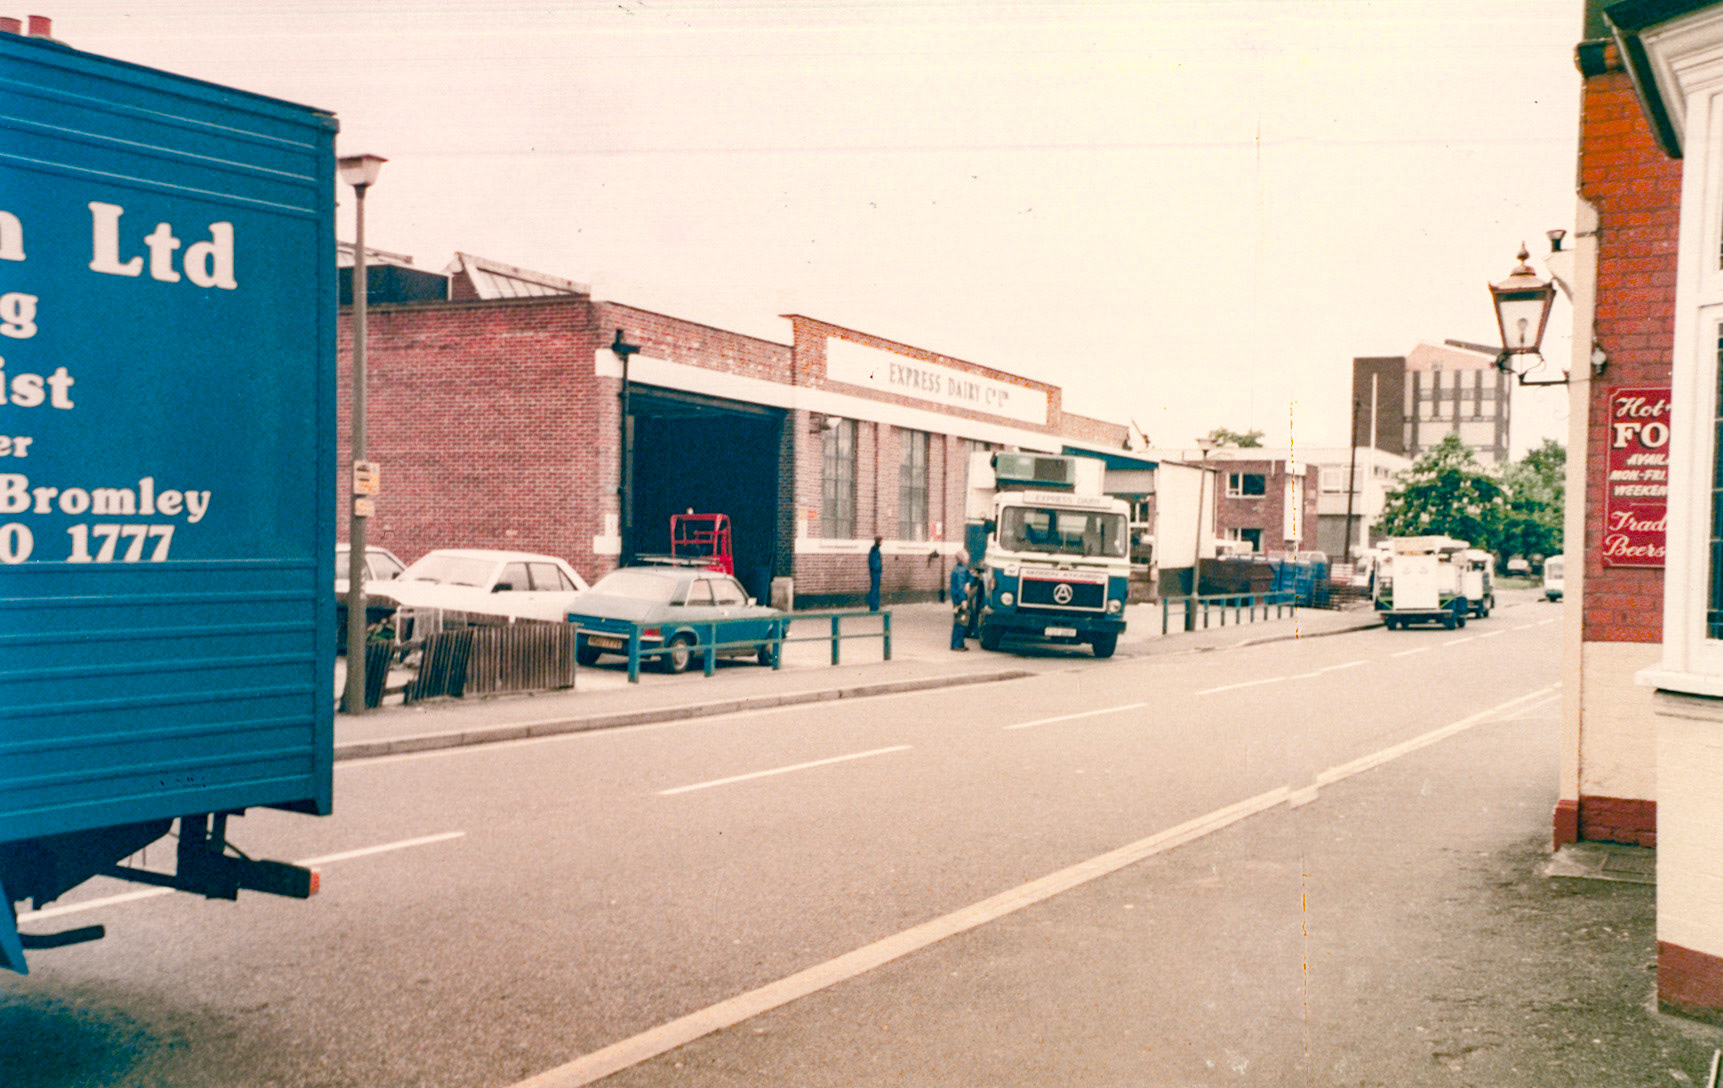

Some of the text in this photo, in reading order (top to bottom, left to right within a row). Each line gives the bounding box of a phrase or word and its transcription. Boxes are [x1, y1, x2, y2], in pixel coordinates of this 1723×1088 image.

[88, 201, 238, 290] Ltd
[889, 362, 942, 393] EXPRESS
[948, 377, 980, 402] DAIRY
[1627, 453, 1669, 466] AVAIL
[0, 473, 211, 523] Bromley
[1035, 494, 1073, 504] EXPRESS
[66, 523, 175, 563] 1777
